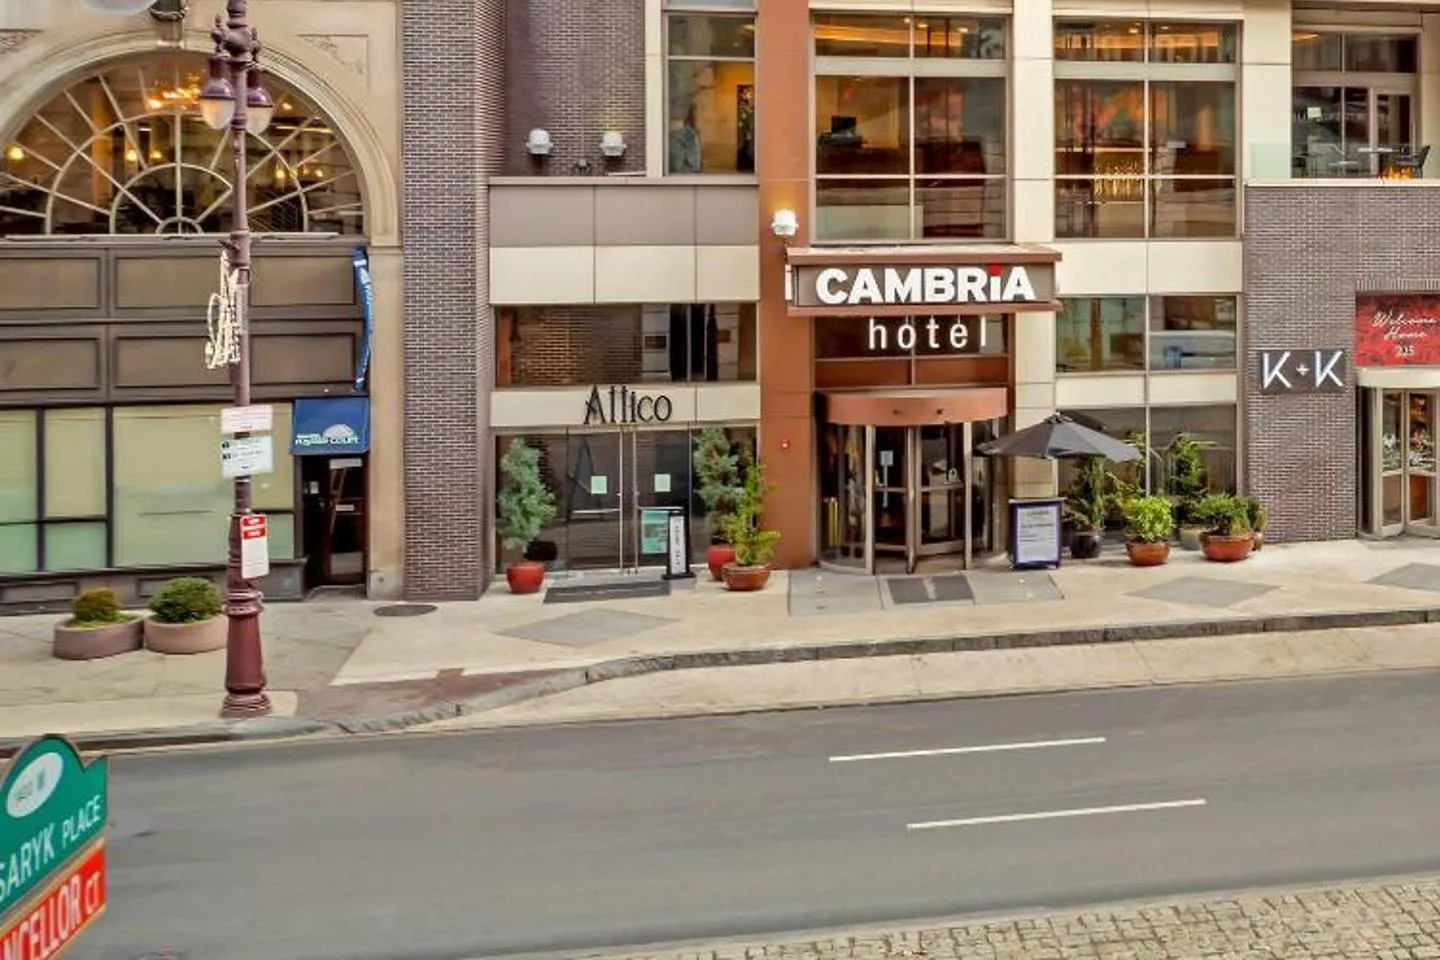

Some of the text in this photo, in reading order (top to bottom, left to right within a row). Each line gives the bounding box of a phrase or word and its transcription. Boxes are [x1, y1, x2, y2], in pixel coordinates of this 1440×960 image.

[868, 315, 987, 350] hotel
[1371, 309, 1438, 328] Welcome
[62, 794, 102, 850] PLACE
